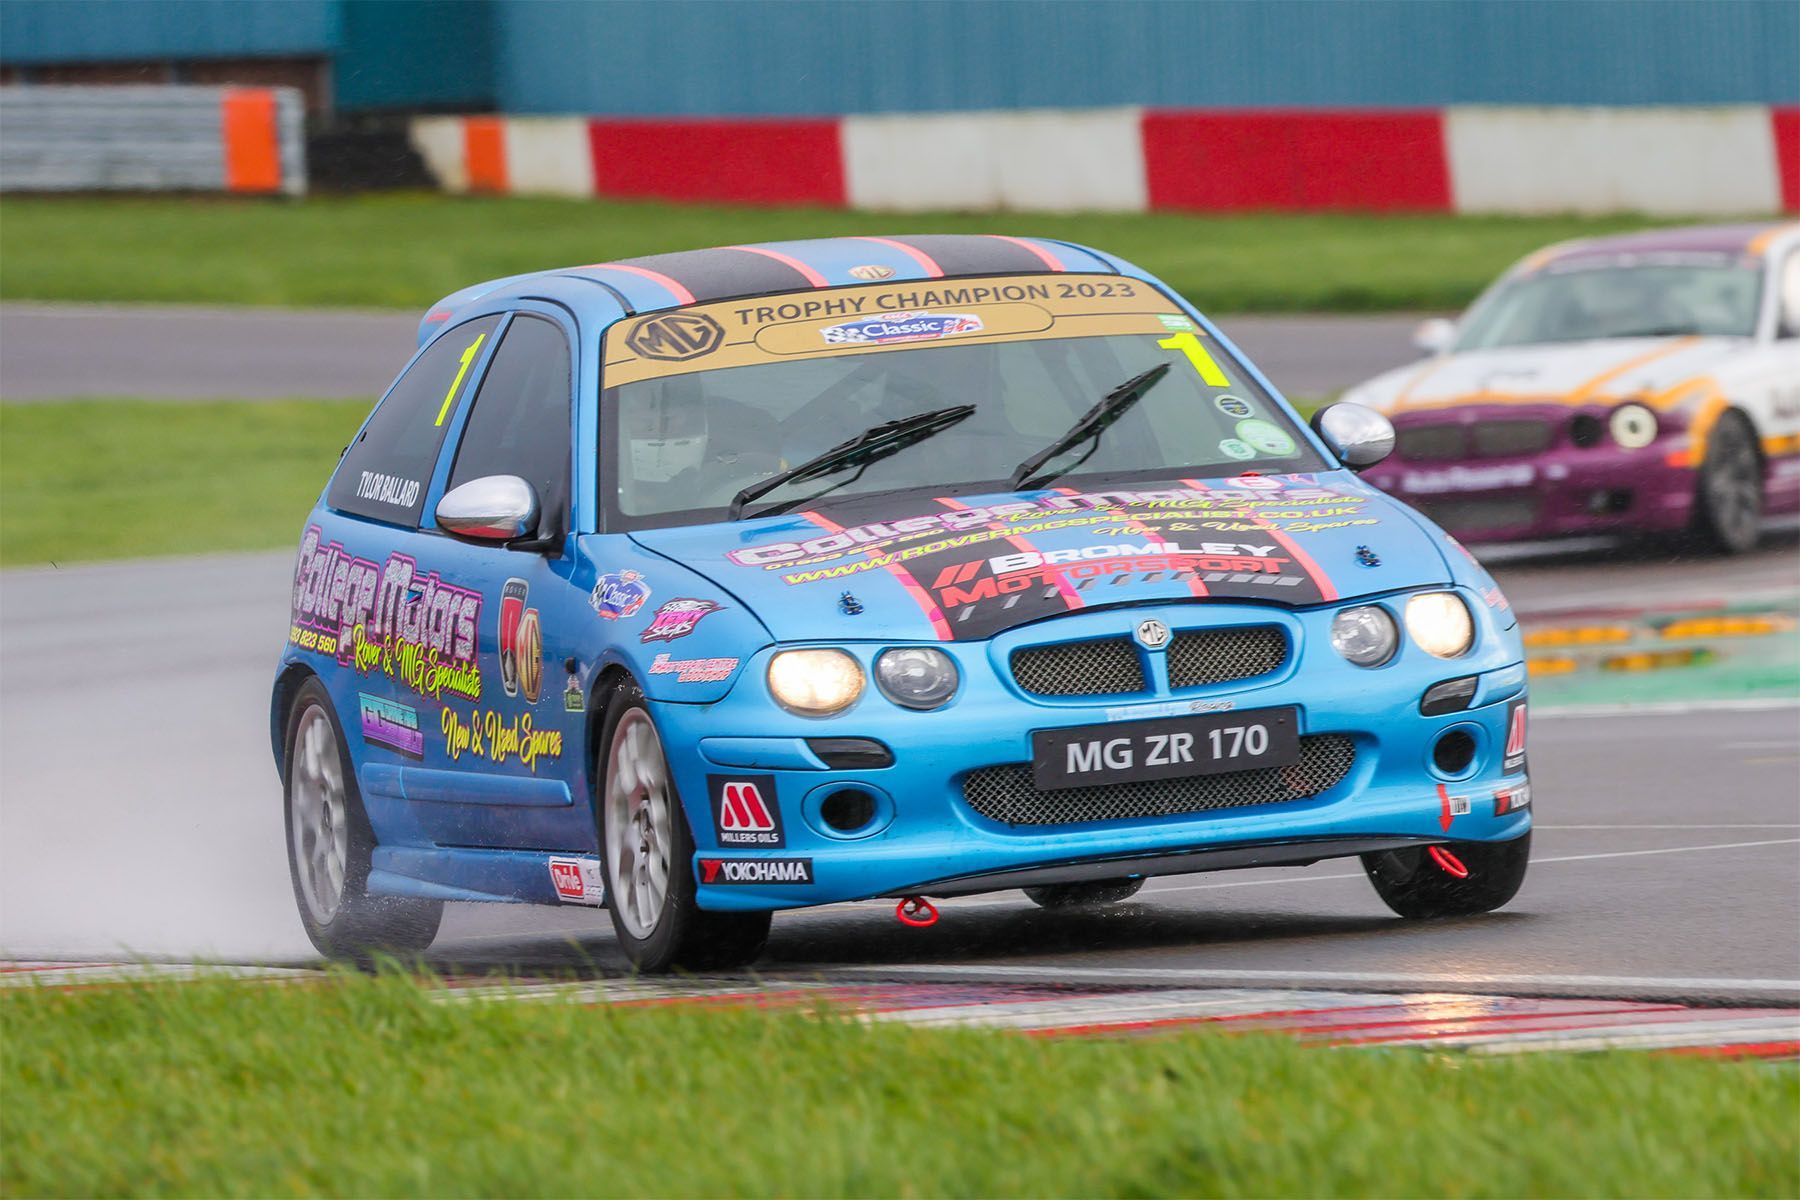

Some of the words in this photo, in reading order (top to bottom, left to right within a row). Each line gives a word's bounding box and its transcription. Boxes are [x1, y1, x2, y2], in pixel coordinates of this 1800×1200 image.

[734, 297, 866, 325] TROPHY
[876, 284, 1050, 310] CHAMPION
[1056, 282, 1137, 298] 2023
[633, 314, 717, 357] MG
[861, 320, 942, 337] Classic
[434, 333, 486, 426] 1
[1156, 332, 1232, 387] 1
[379, 475, 421, 508] BALLARD
[729, 500, 1041, 565] College
[989, 541, 1278, 574] BROMLEY
[939, 556, 1290, 609] MOTORSPORT
[317, 635, 337, 654] 560
[353, 623, 380, 671] Rover
[395, 637, 425, 695] MG
[425, 648, 481, 701] Specialists
[441, 706, 470, 760] New
[472, 709, 484, 756] &
[485, 711, 518, 762] Used
[520, 712, 562, 773] Spares
[1066, 738, 1134, 774] MG
[1144, 732, 1195, 767] ZR
[1208, 724, 1269, 760] 170
[720, 832, 758, 843] MILLERS
[758, 832, 780, 843] OILS
[721, 861, 809, 881] YOKOHAMA
